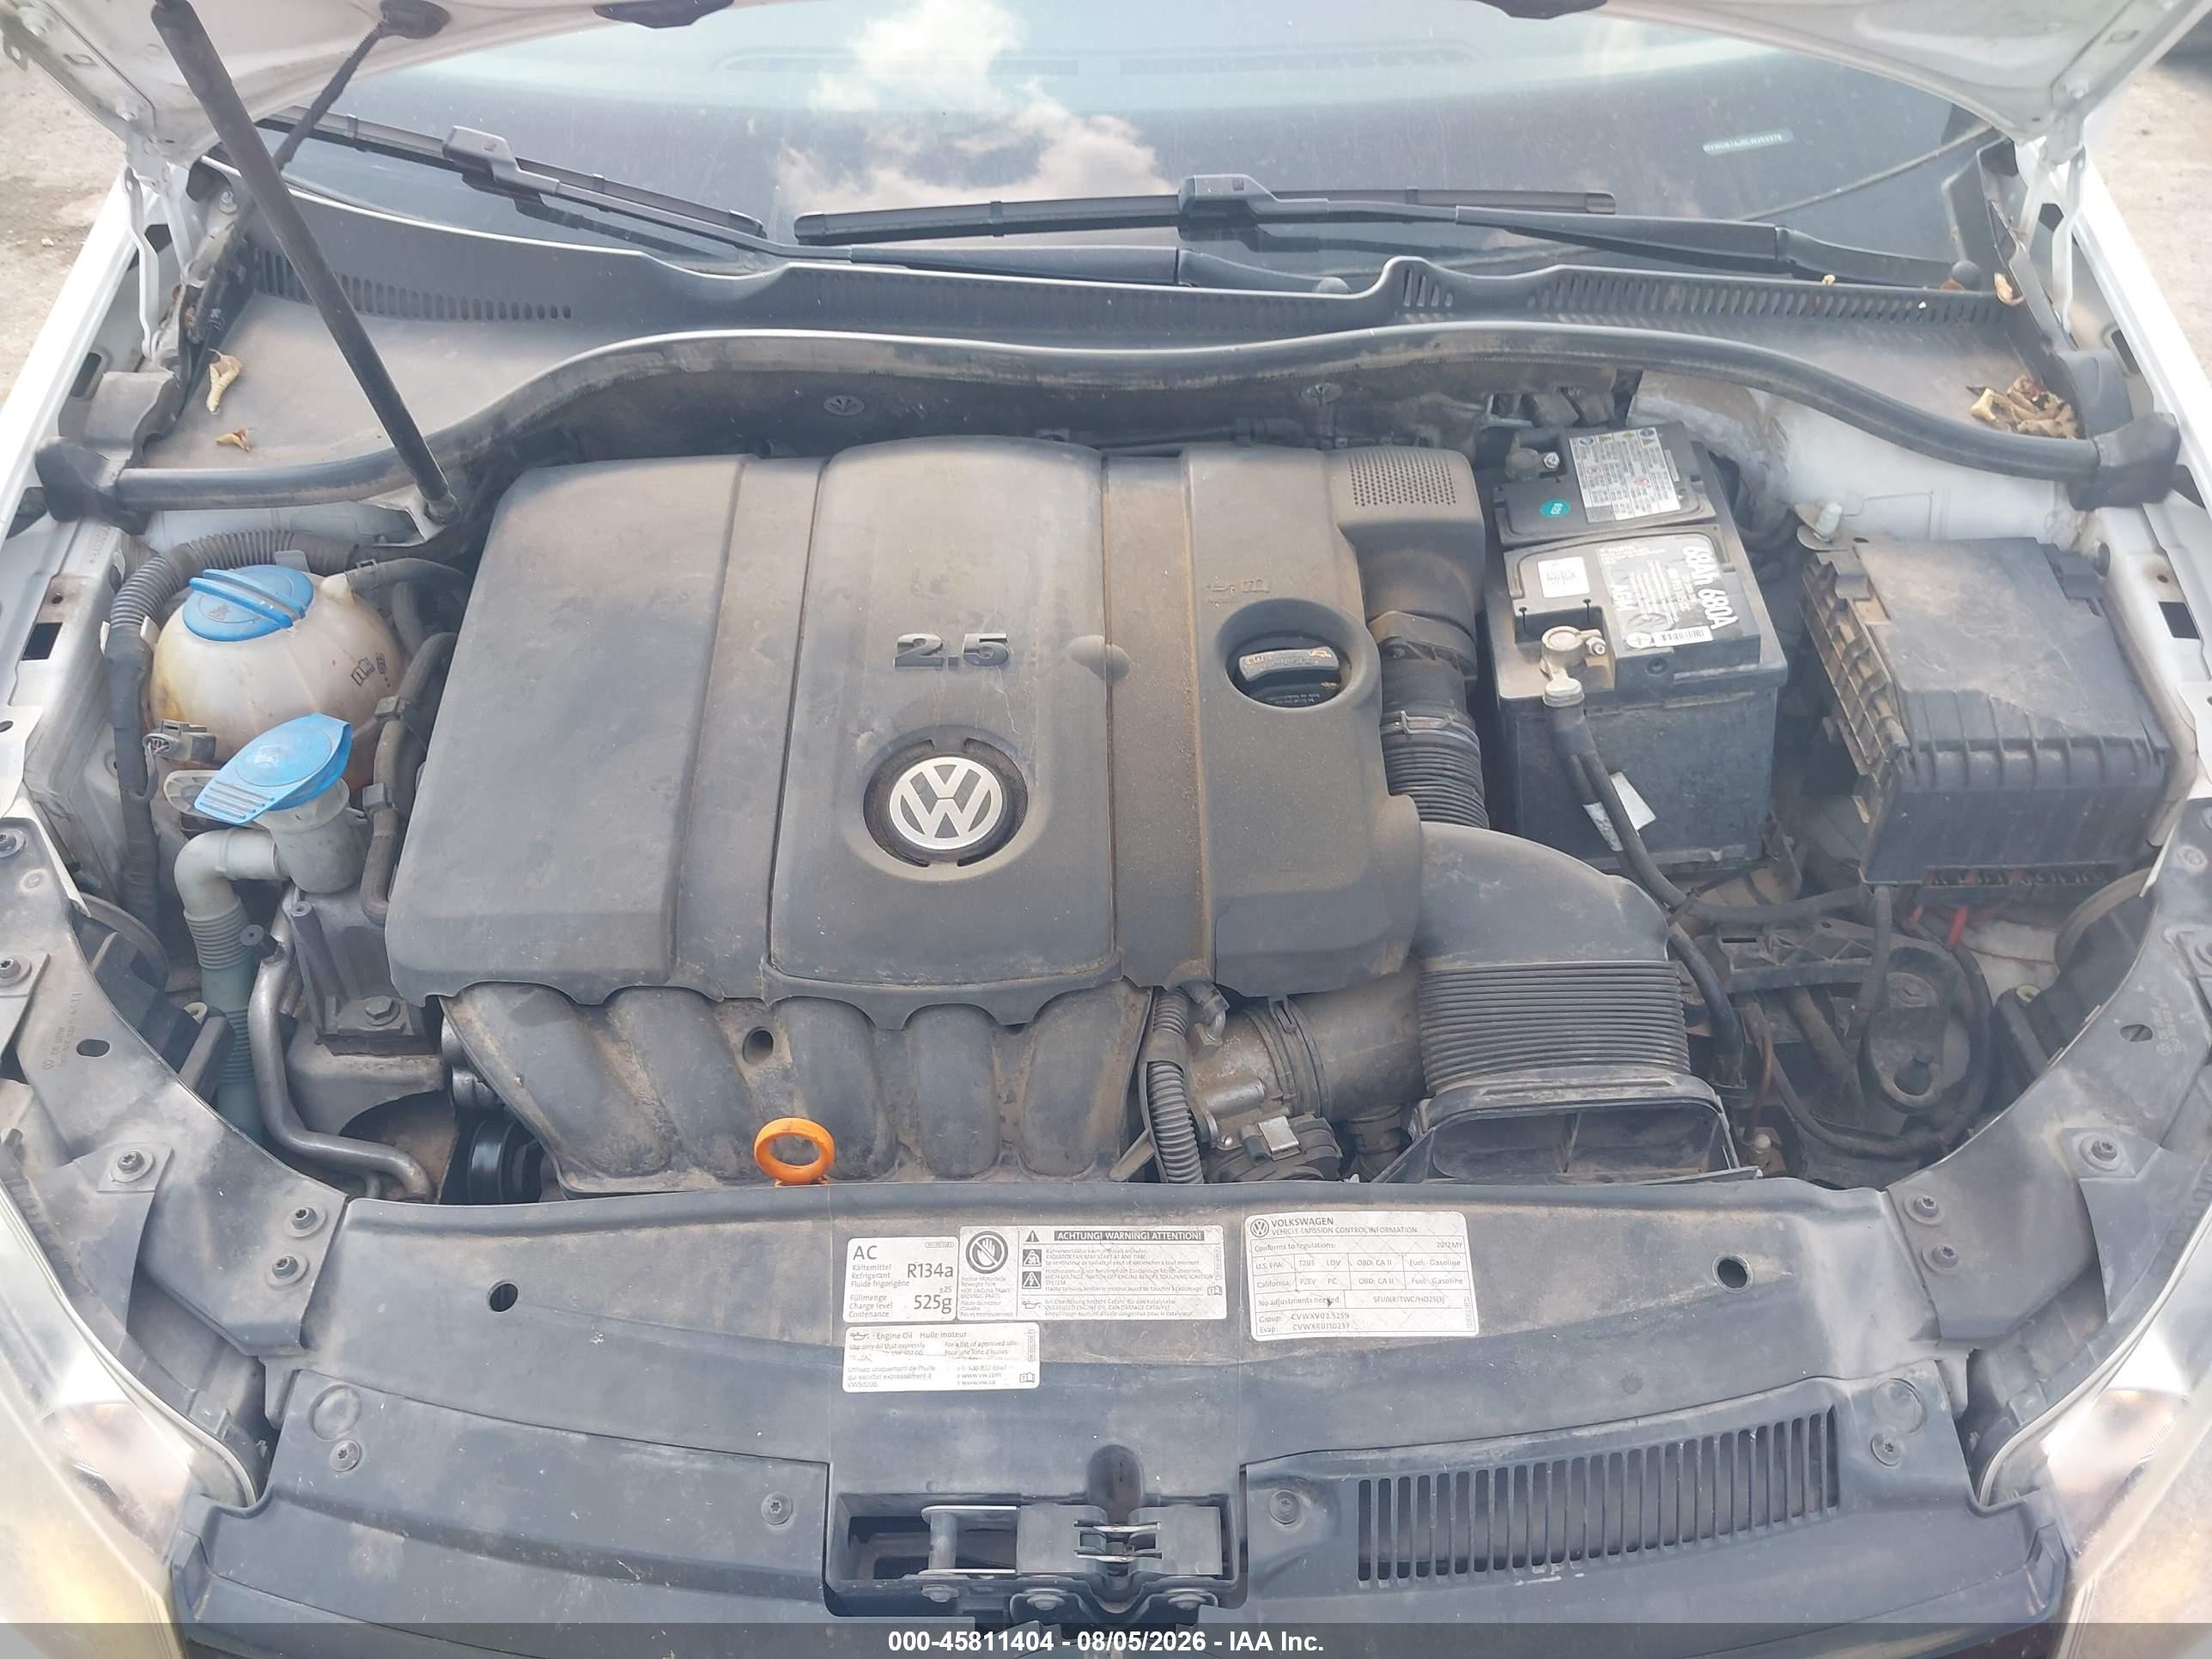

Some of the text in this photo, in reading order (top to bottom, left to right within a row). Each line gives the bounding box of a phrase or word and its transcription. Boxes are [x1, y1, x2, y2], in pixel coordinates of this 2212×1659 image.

[1682, 546, 1722, 585] 68Ah
[1697, 588, 1739, 630] 680A
[893, 633, 1011, 667] 2.5
[1271, 1218, 1334, 1227] VOLKSWAGEN
[1057, 1231, 1201, 1240] ACHTUNG! WARNING! ATTENTION!
[853, 1245, 878, 1260] AC
[907, 1262, 954, 1278] R134a
[851, 1272, 890, 1281] Refrigerant
[850, 1294, 887, 1303] Füllmenge
[1269, 1297, 1313, 1307] adjustments
[849, 1303, 874, 1311] Charge
[914, 1294, 952, 1314] 525g
[877, 1332, 901, 1340] Engine
